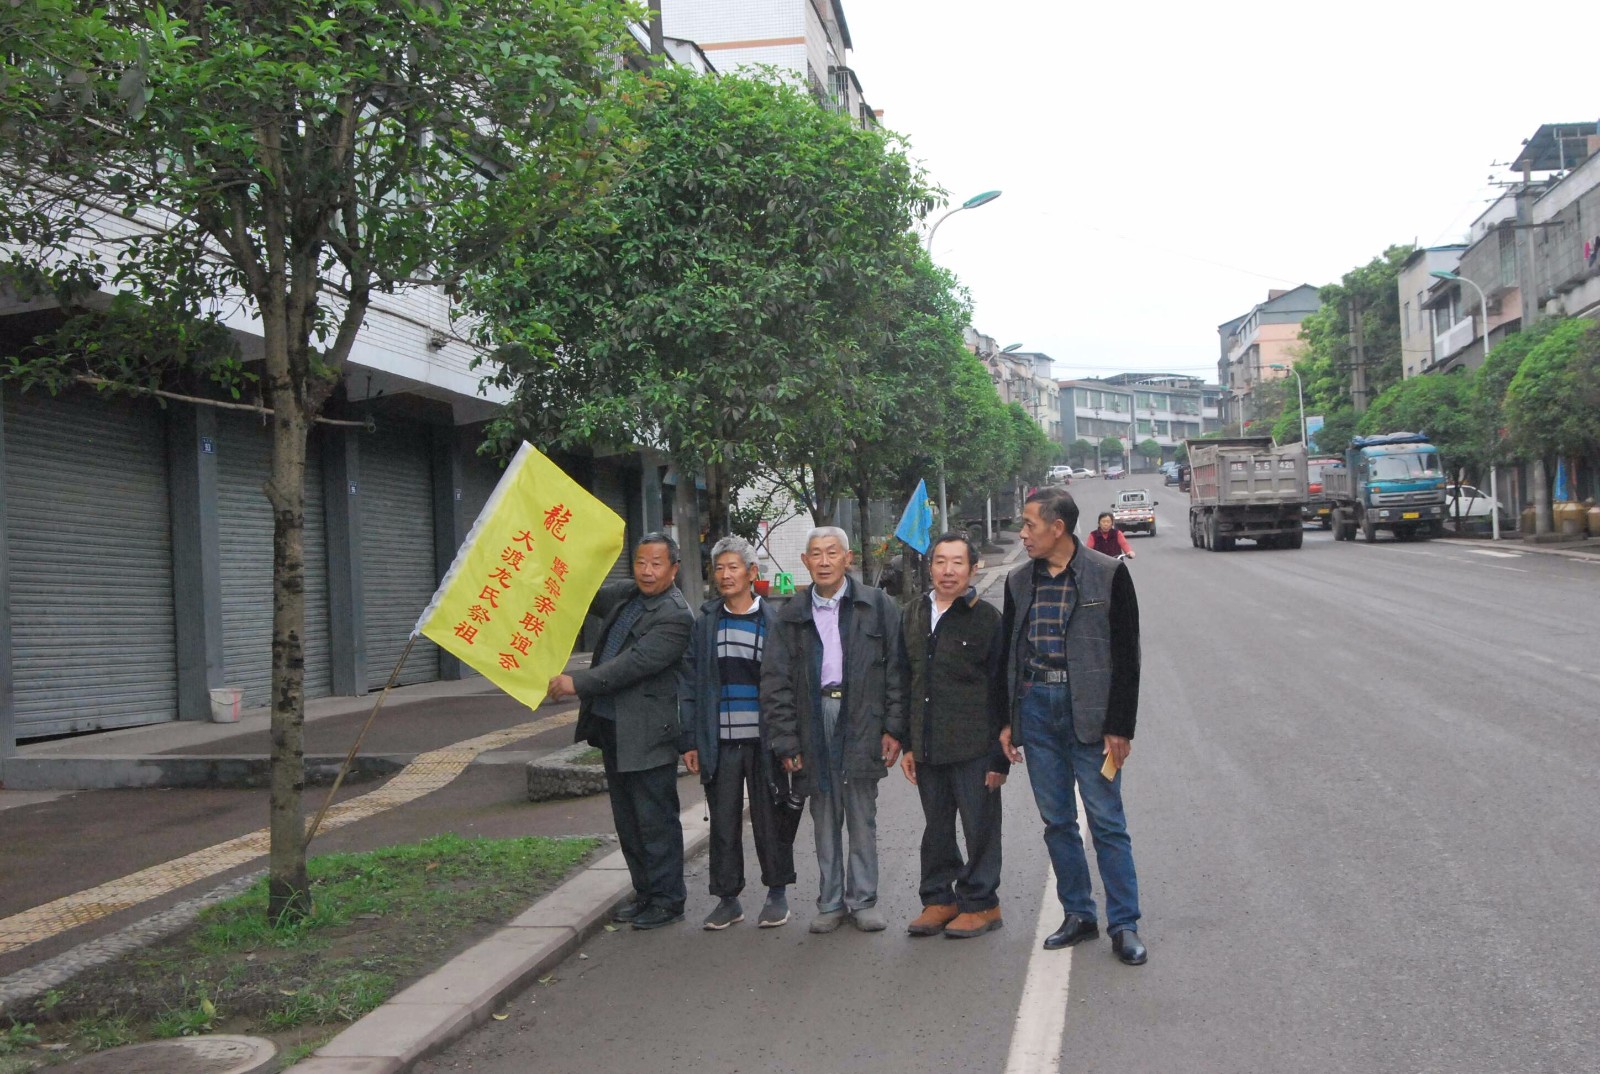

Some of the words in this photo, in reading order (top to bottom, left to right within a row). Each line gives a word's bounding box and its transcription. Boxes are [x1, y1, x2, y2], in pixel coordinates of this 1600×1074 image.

[543, 502, 574, 543] 龍
[454, 530, 535, 646] 大渡龙氏祭祖
